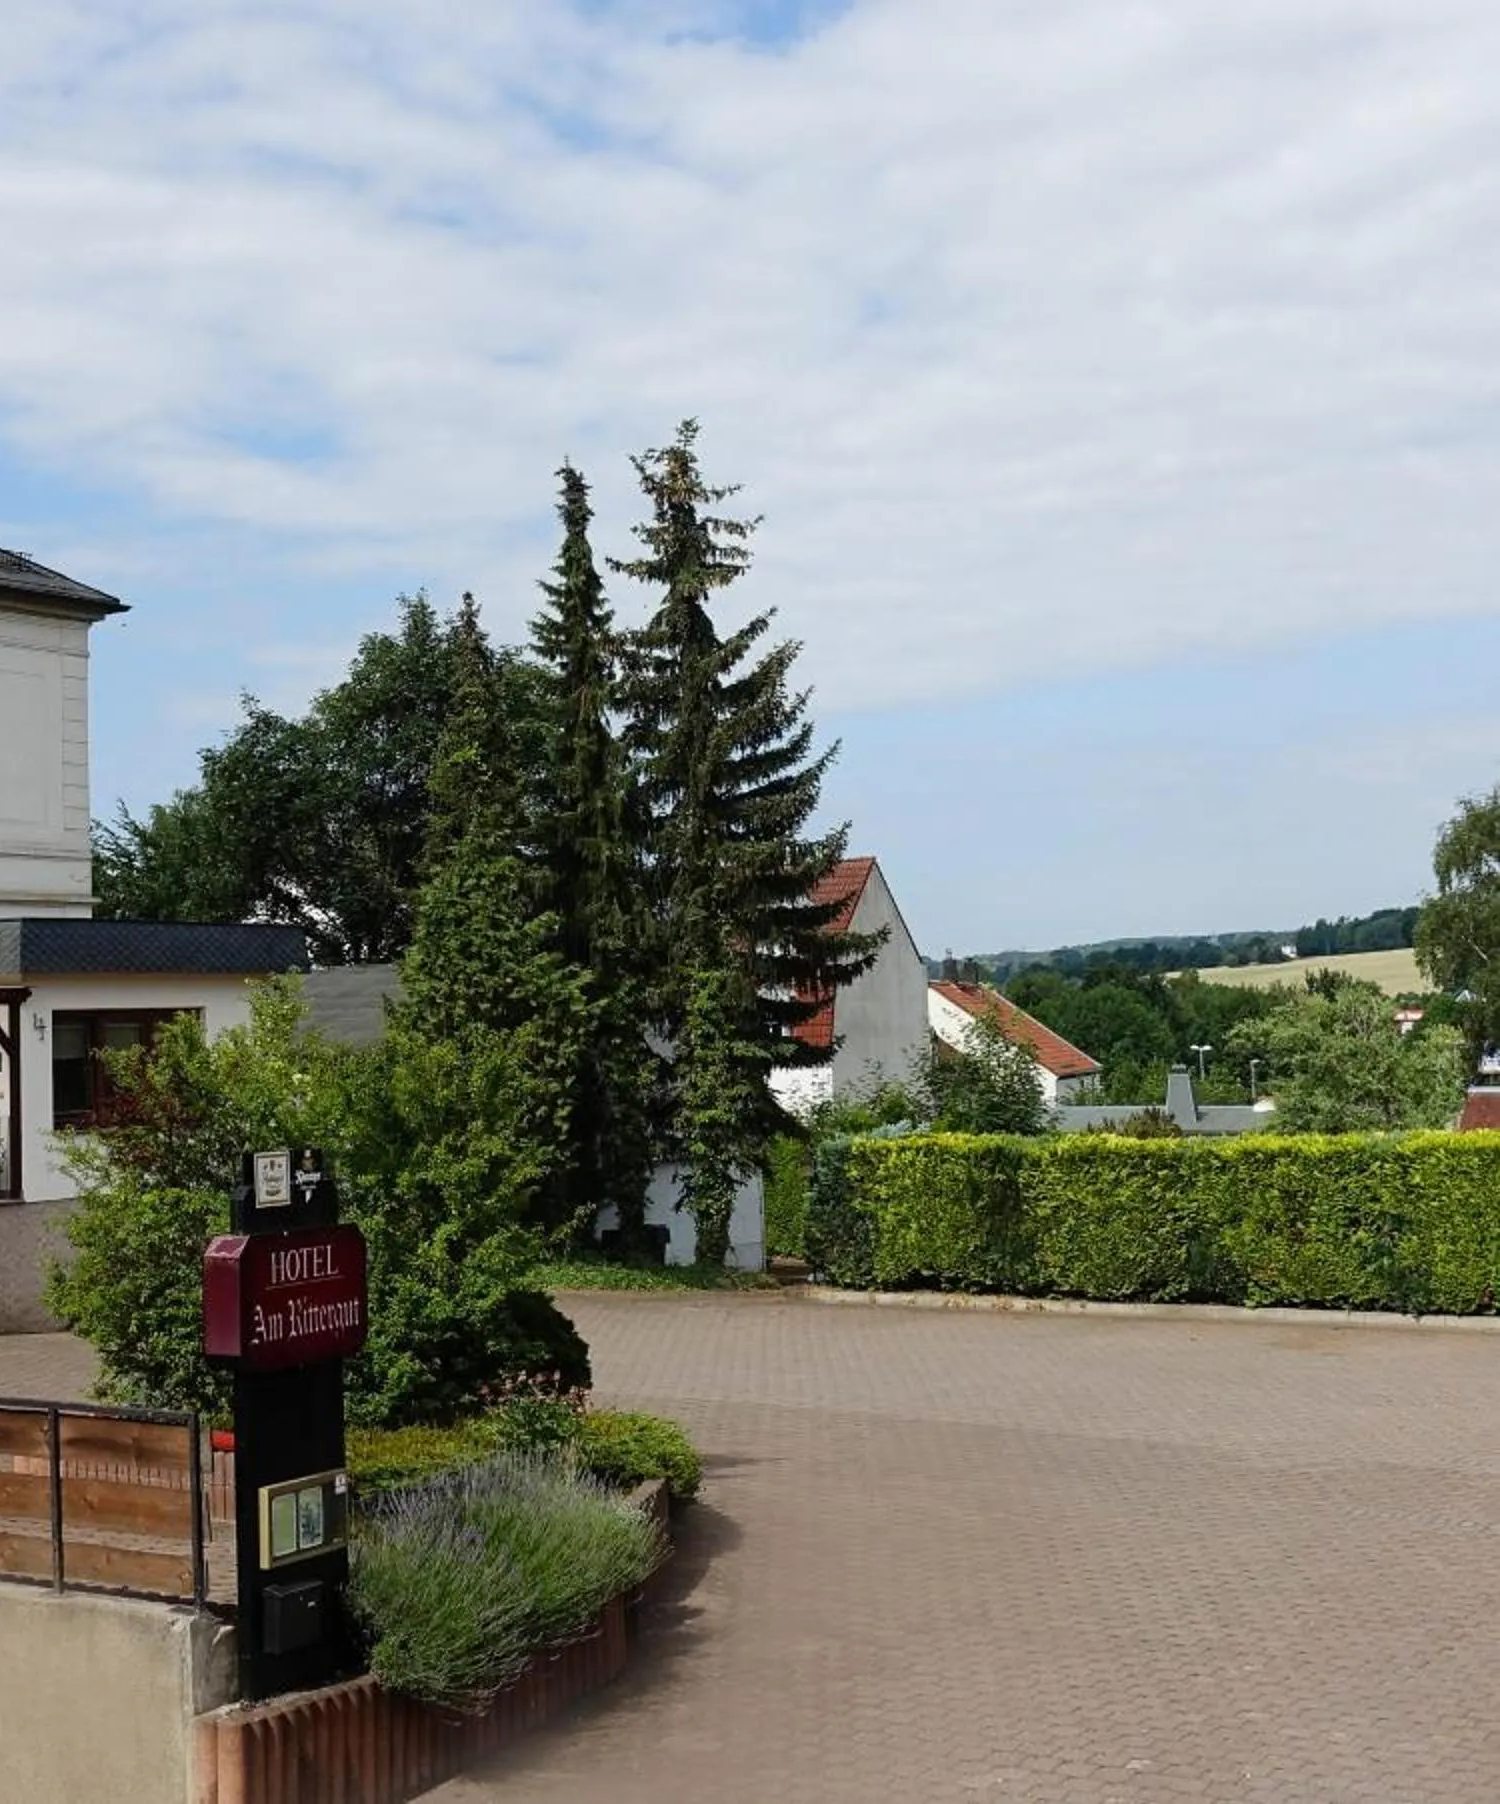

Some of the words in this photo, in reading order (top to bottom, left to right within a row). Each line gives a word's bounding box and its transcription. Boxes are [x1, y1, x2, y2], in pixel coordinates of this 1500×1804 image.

[270, 1244, 339, 1284] HOTEL
[251, 1304, 284, 1345] Am
[287, 1297, 360, 1338] Rittergut
